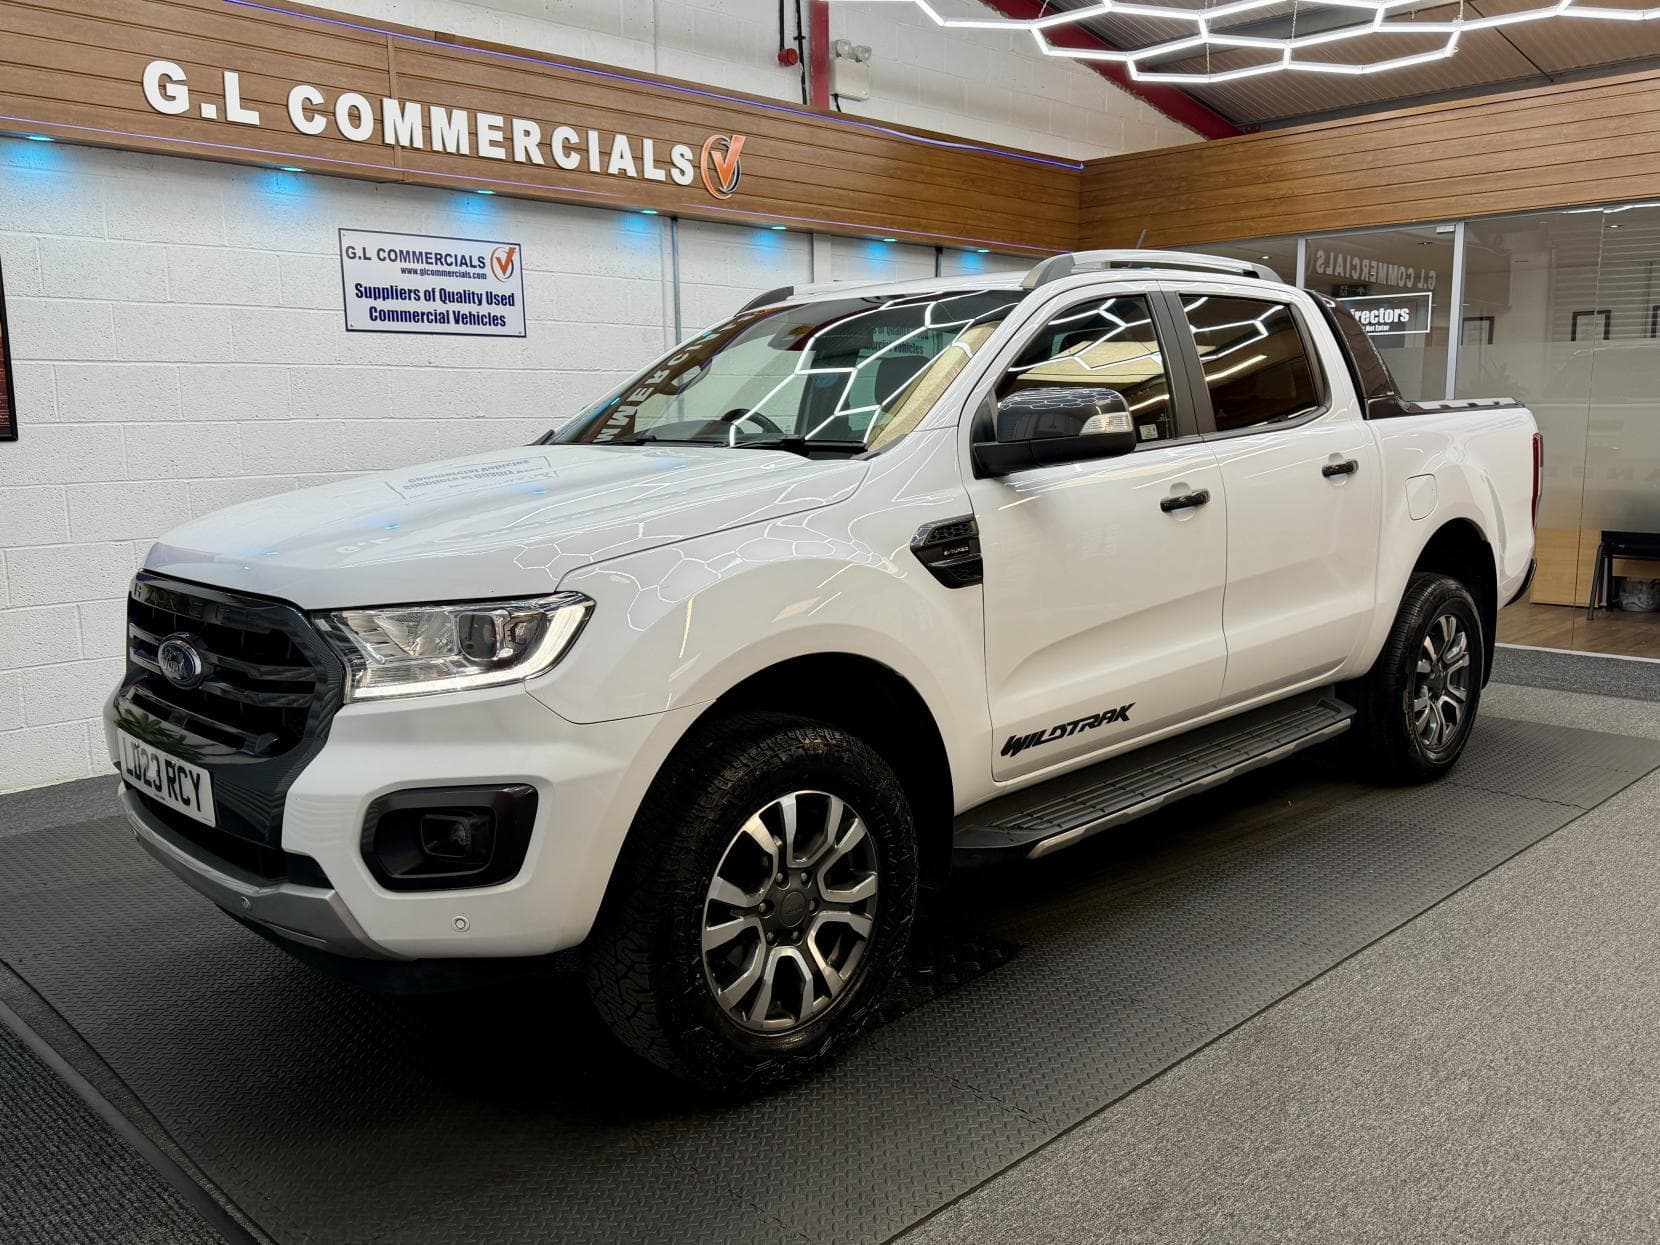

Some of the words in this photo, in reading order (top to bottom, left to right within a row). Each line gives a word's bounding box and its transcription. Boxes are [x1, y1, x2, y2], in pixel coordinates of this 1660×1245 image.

[143, 60, 260, 126] G.L
[287, 85, 695, 186] COMMERCIALS
[345, 245, 372, 260] G.L
[377, 248, 486, 269] COMMERCIALS
[400, 266, 487, 280] www.glcommercials.com
[354, 283, 421, 301] Suppliers
[424, 287, 436, 302] of
[439, 288, 483, 306] Quality
[486, 291, 515, 307] Used
[369, 306, 450, 325] Commercial
[452, 310, 506, 327] Vehicles
[1351, 308, 1410, 324] irectors
[1000, 702, 1136, 757] WILDTRAK
[164, 758, 202, 813] RCY
